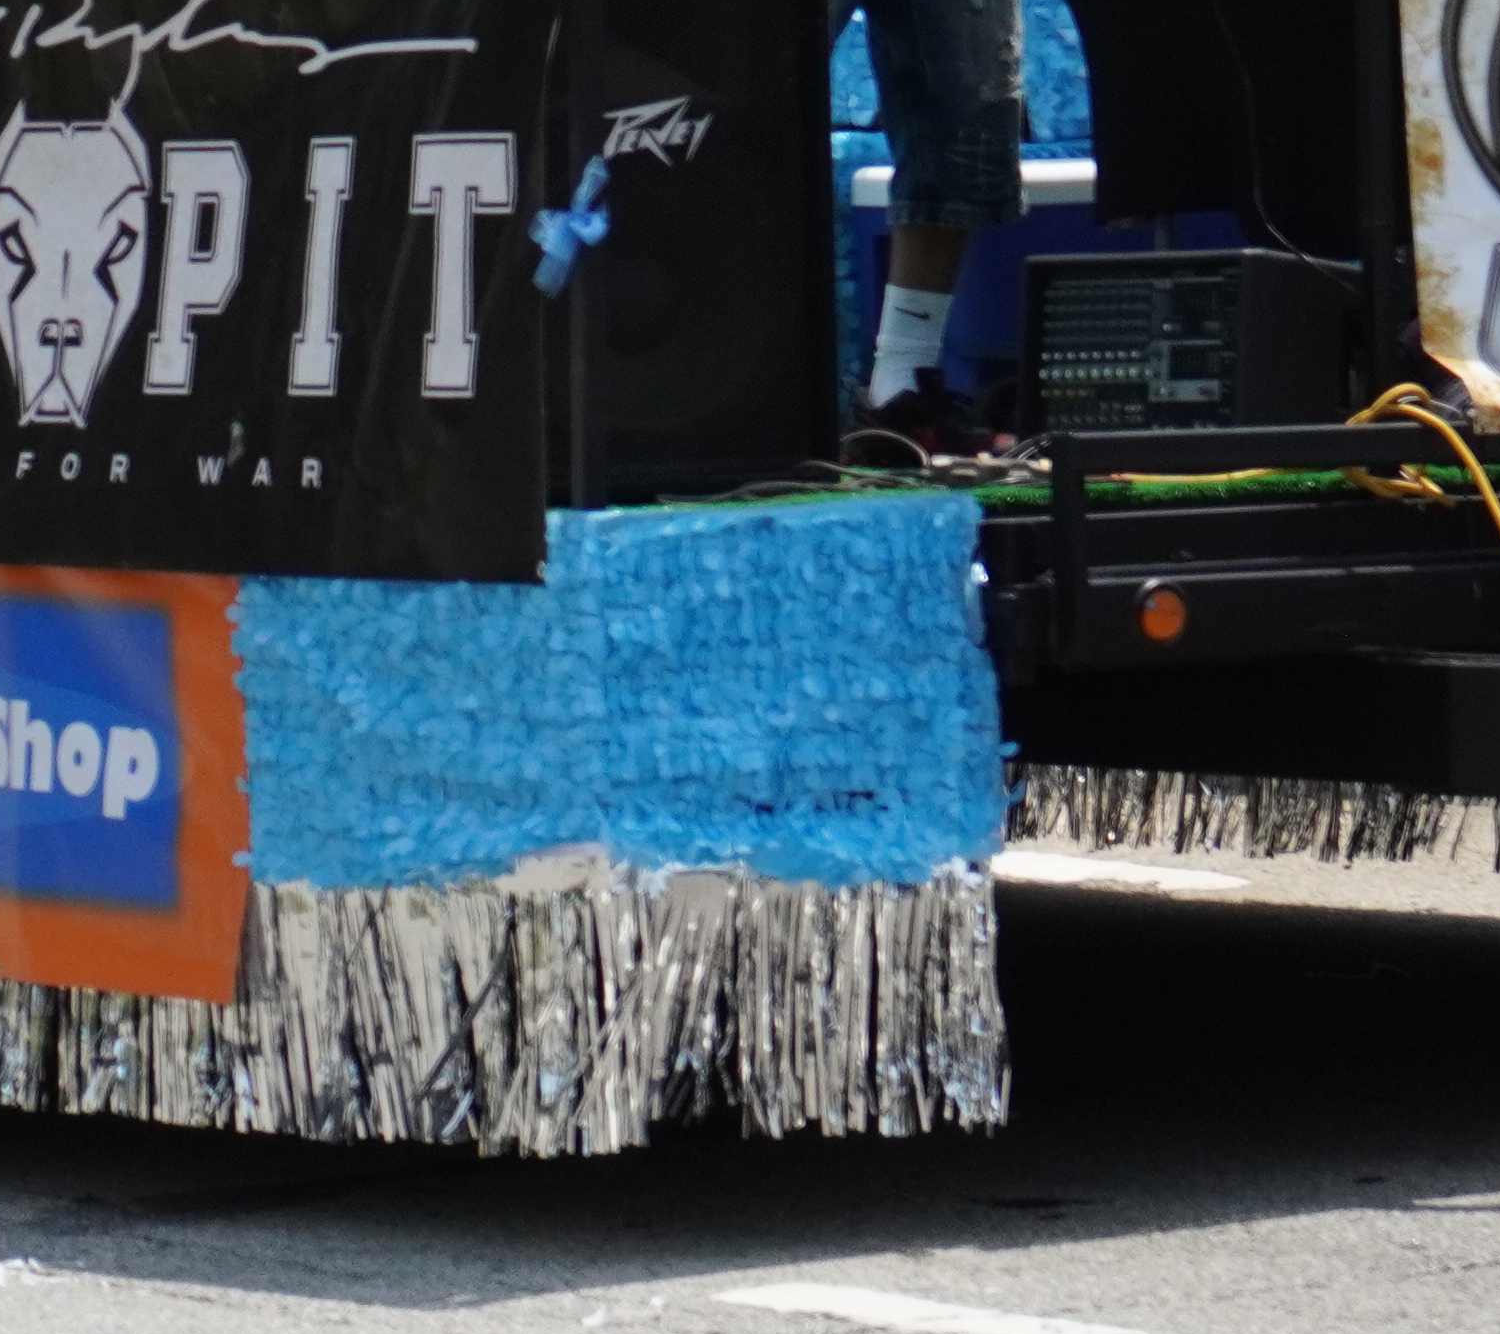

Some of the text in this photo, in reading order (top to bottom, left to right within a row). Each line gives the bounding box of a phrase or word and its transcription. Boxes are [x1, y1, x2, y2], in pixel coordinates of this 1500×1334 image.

[142, 131, 518, 399] PIT
[14, 451, 131, 484] FOR
[197, 455, 323, 489] WAR
